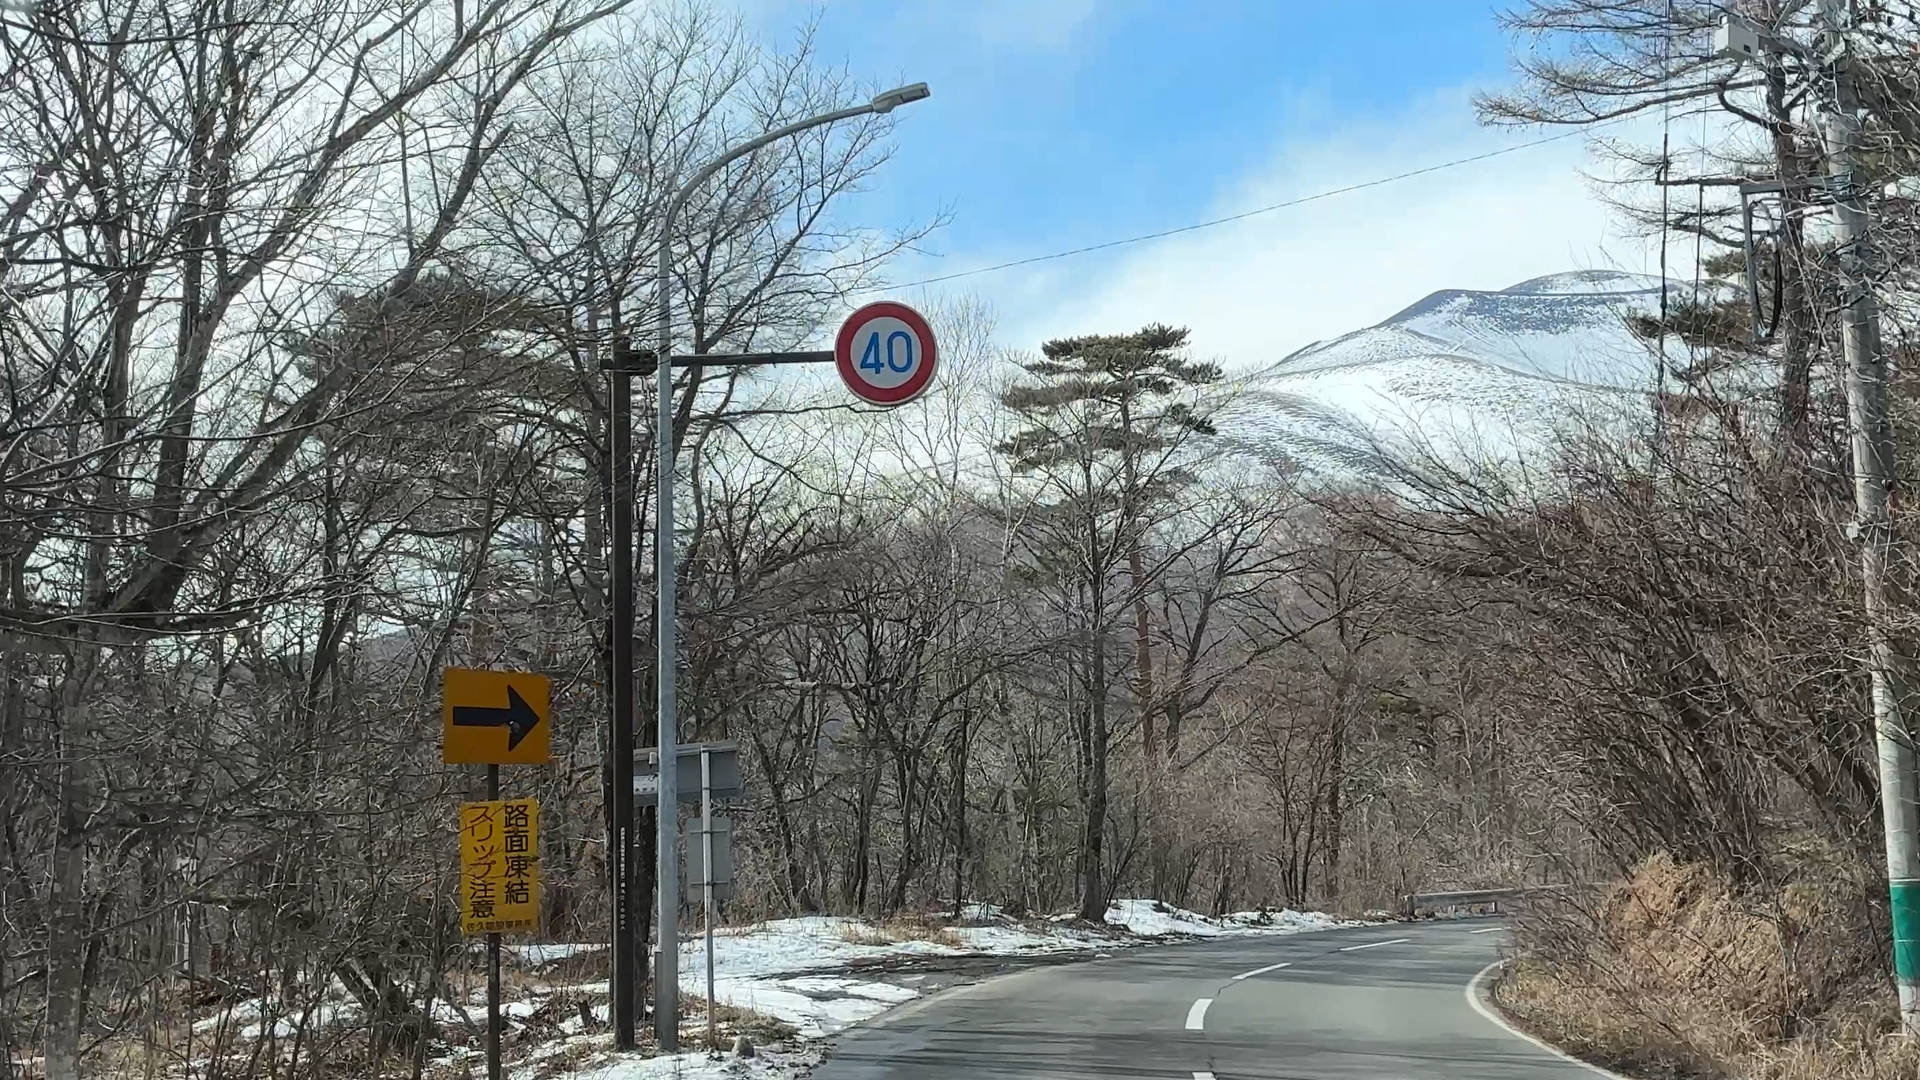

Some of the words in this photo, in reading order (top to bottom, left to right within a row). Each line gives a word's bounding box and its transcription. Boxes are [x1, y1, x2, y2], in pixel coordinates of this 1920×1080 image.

[860, 331, 913, 374] 40
[469, 806, 496, 918] スリップ注意
[504, 804, 530, 904] 路面凍結
